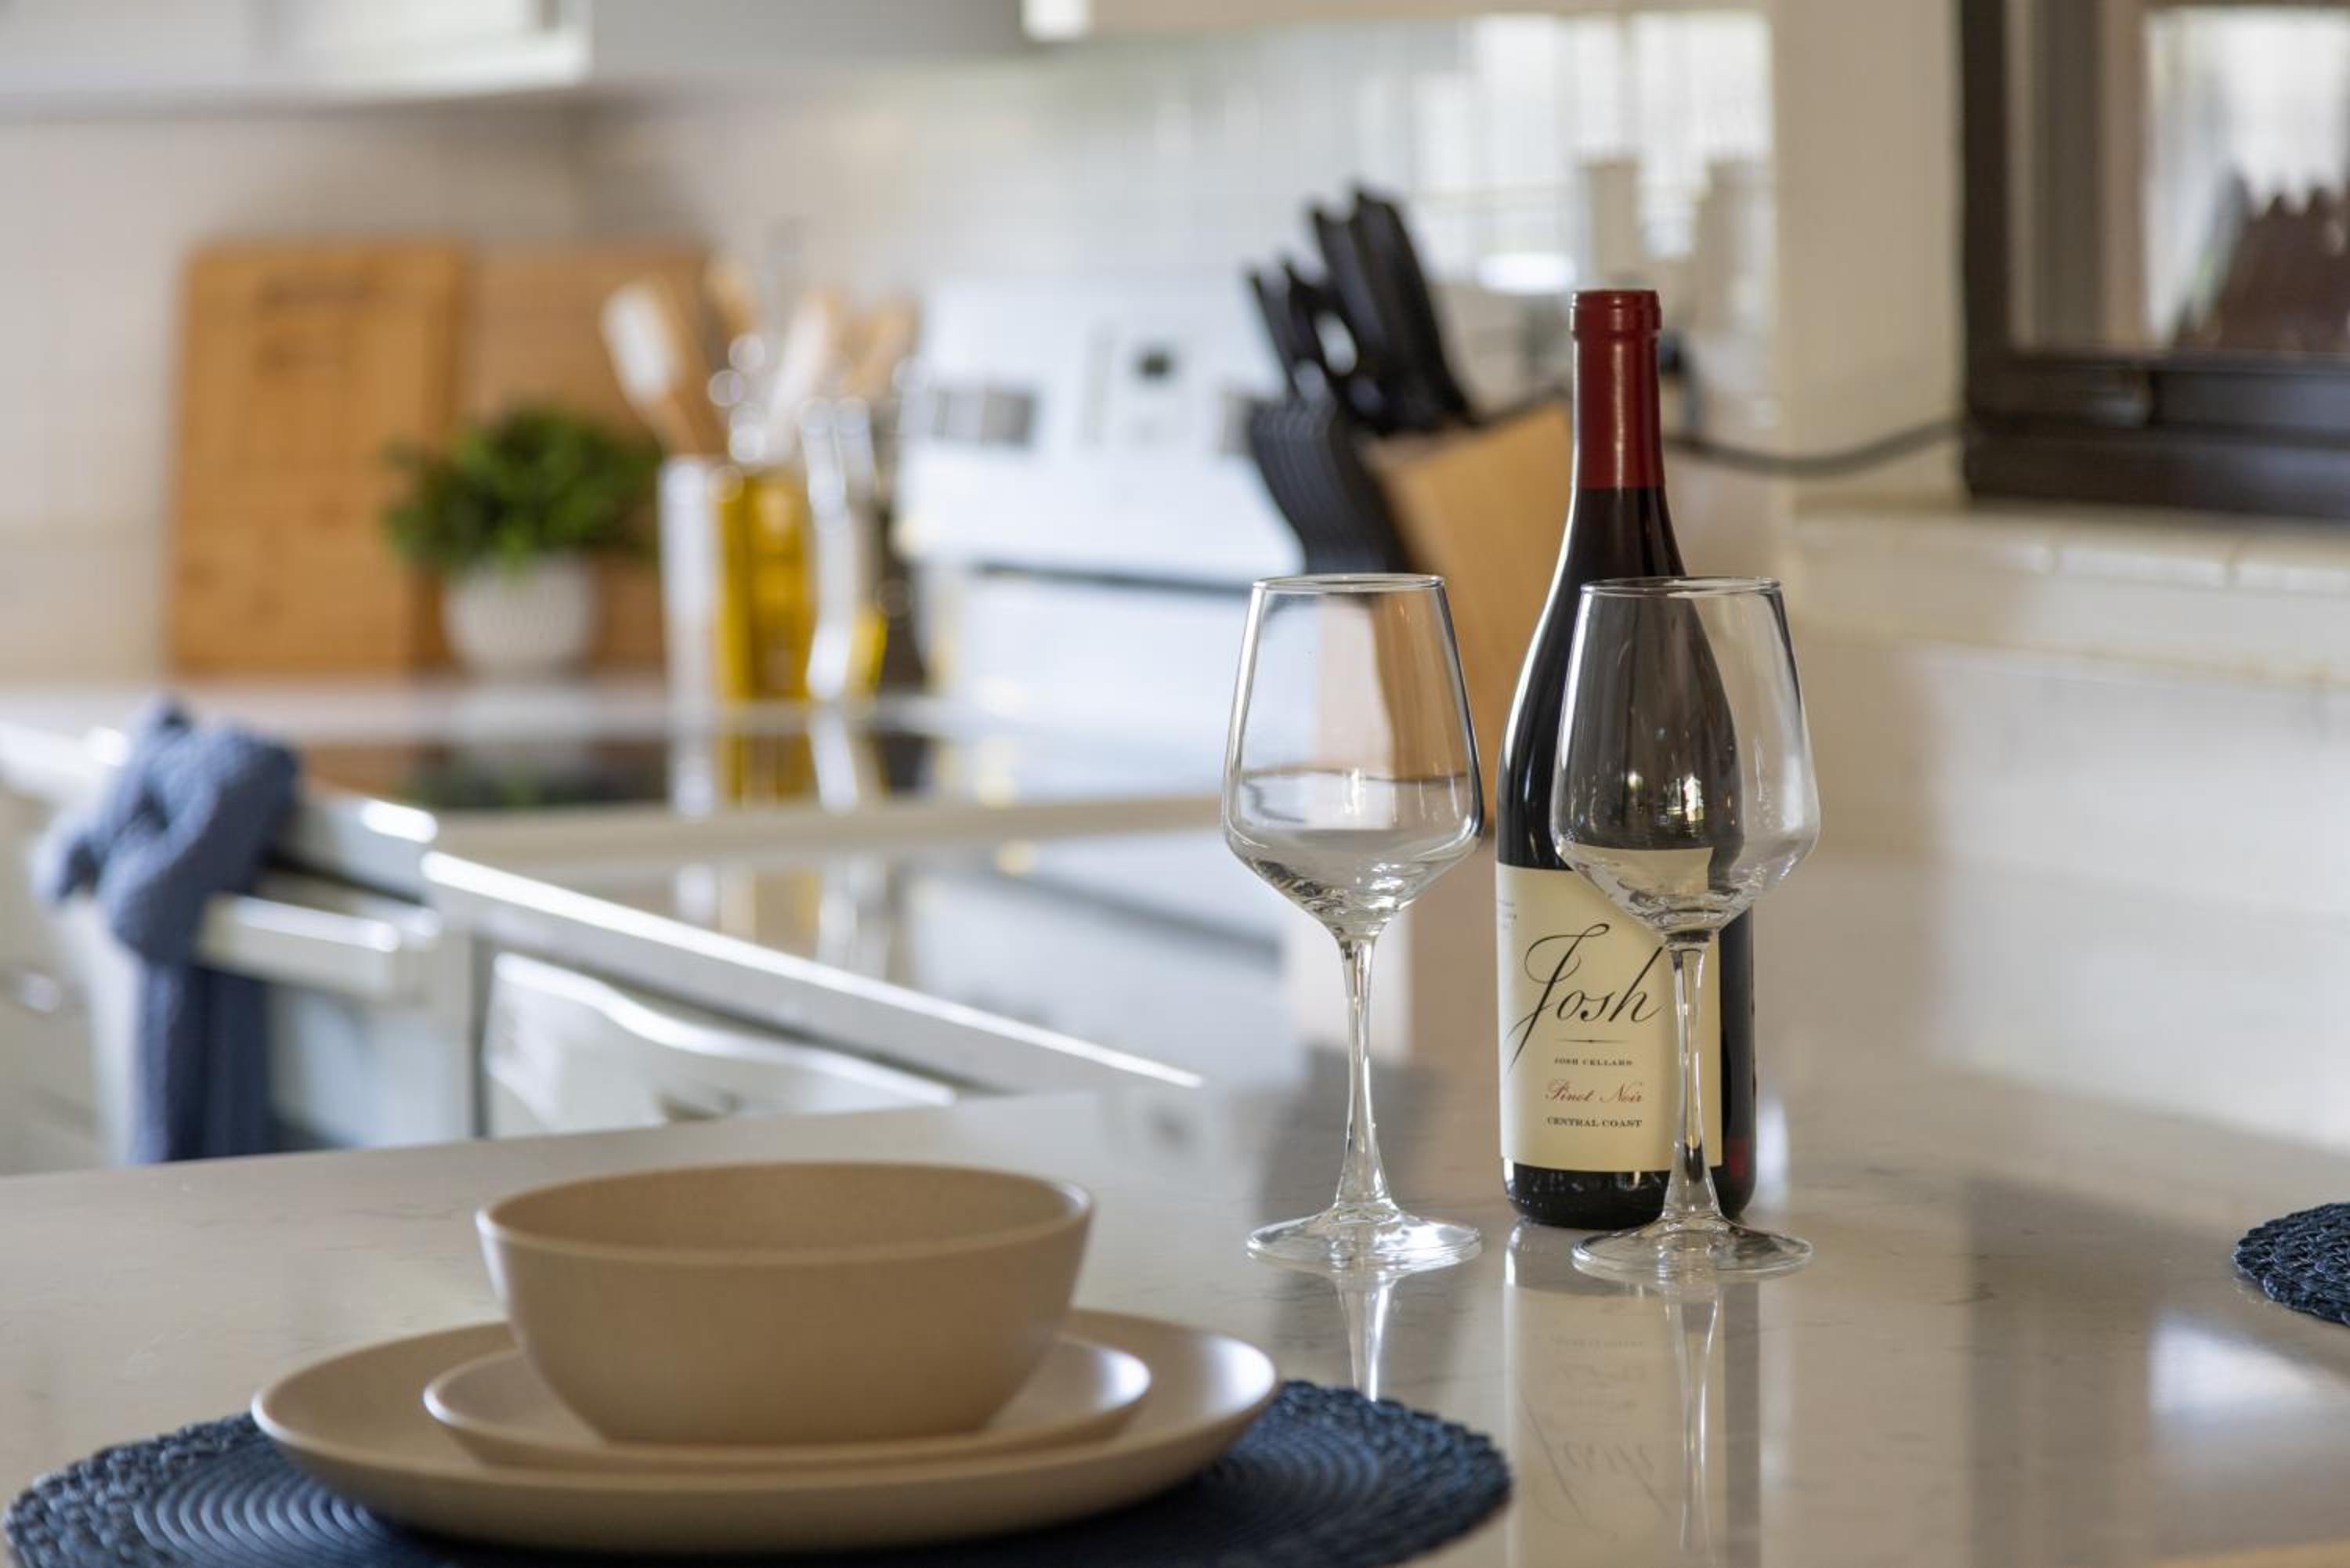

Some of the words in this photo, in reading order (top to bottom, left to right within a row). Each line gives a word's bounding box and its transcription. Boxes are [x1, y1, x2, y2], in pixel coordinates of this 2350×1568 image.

[1508, 923, 1666, 1075] Josh
[1554, 1057, 1578, 1065] JOSH
[1582, 1057, 1632, 1066] CELLARS
[1544, 1078, 1595, 1103] Pinot
[1599, 1080, 1643, 1103] Noir
[1547, 1116, 1599, 1128] CENTRAL
[1602, 1118, 1643, 1128] COAST
